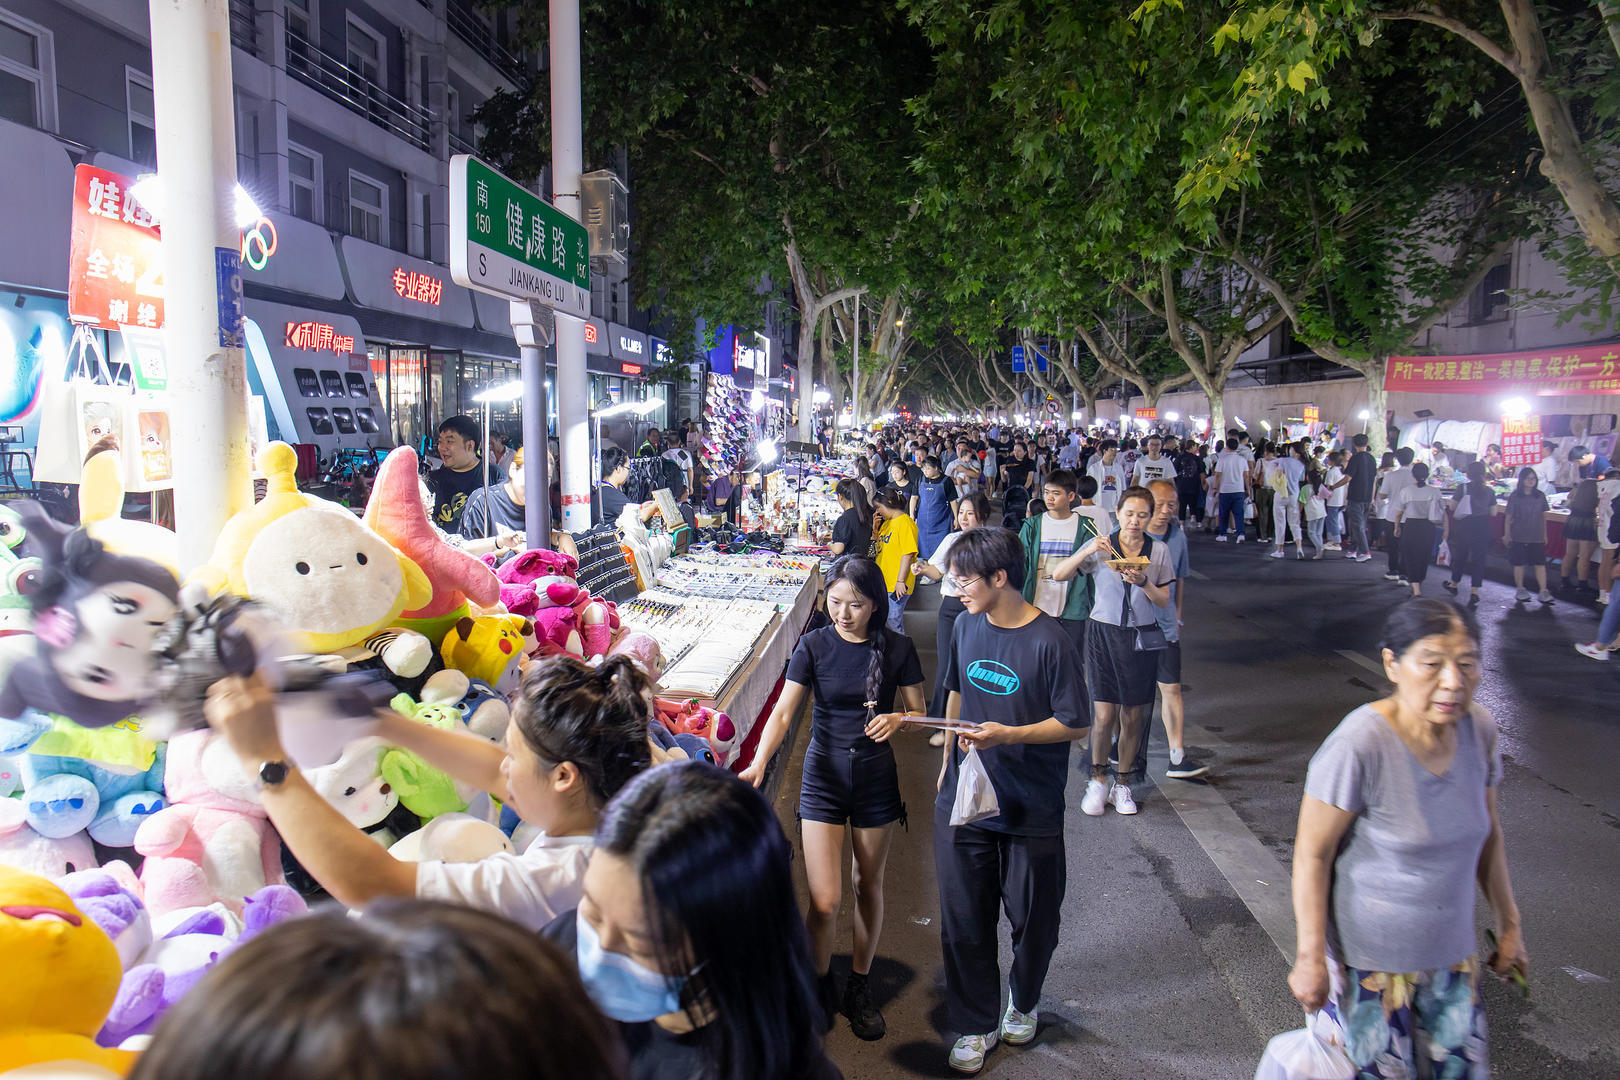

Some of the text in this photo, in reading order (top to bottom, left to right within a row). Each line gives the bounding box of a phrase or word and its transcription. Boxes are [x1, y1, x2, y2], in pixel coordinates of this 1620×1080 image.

[477, 180, 489, 210] 南
[475, 211, 491, 234] 150
[506, 198, 567, 271] 健康路
[479, 252, 487, 277] S
[393, 267, 443, 306] 专业器材
[508, 267, 565, 303] JIANKANG LU
[578, 291, 585, 311] N
